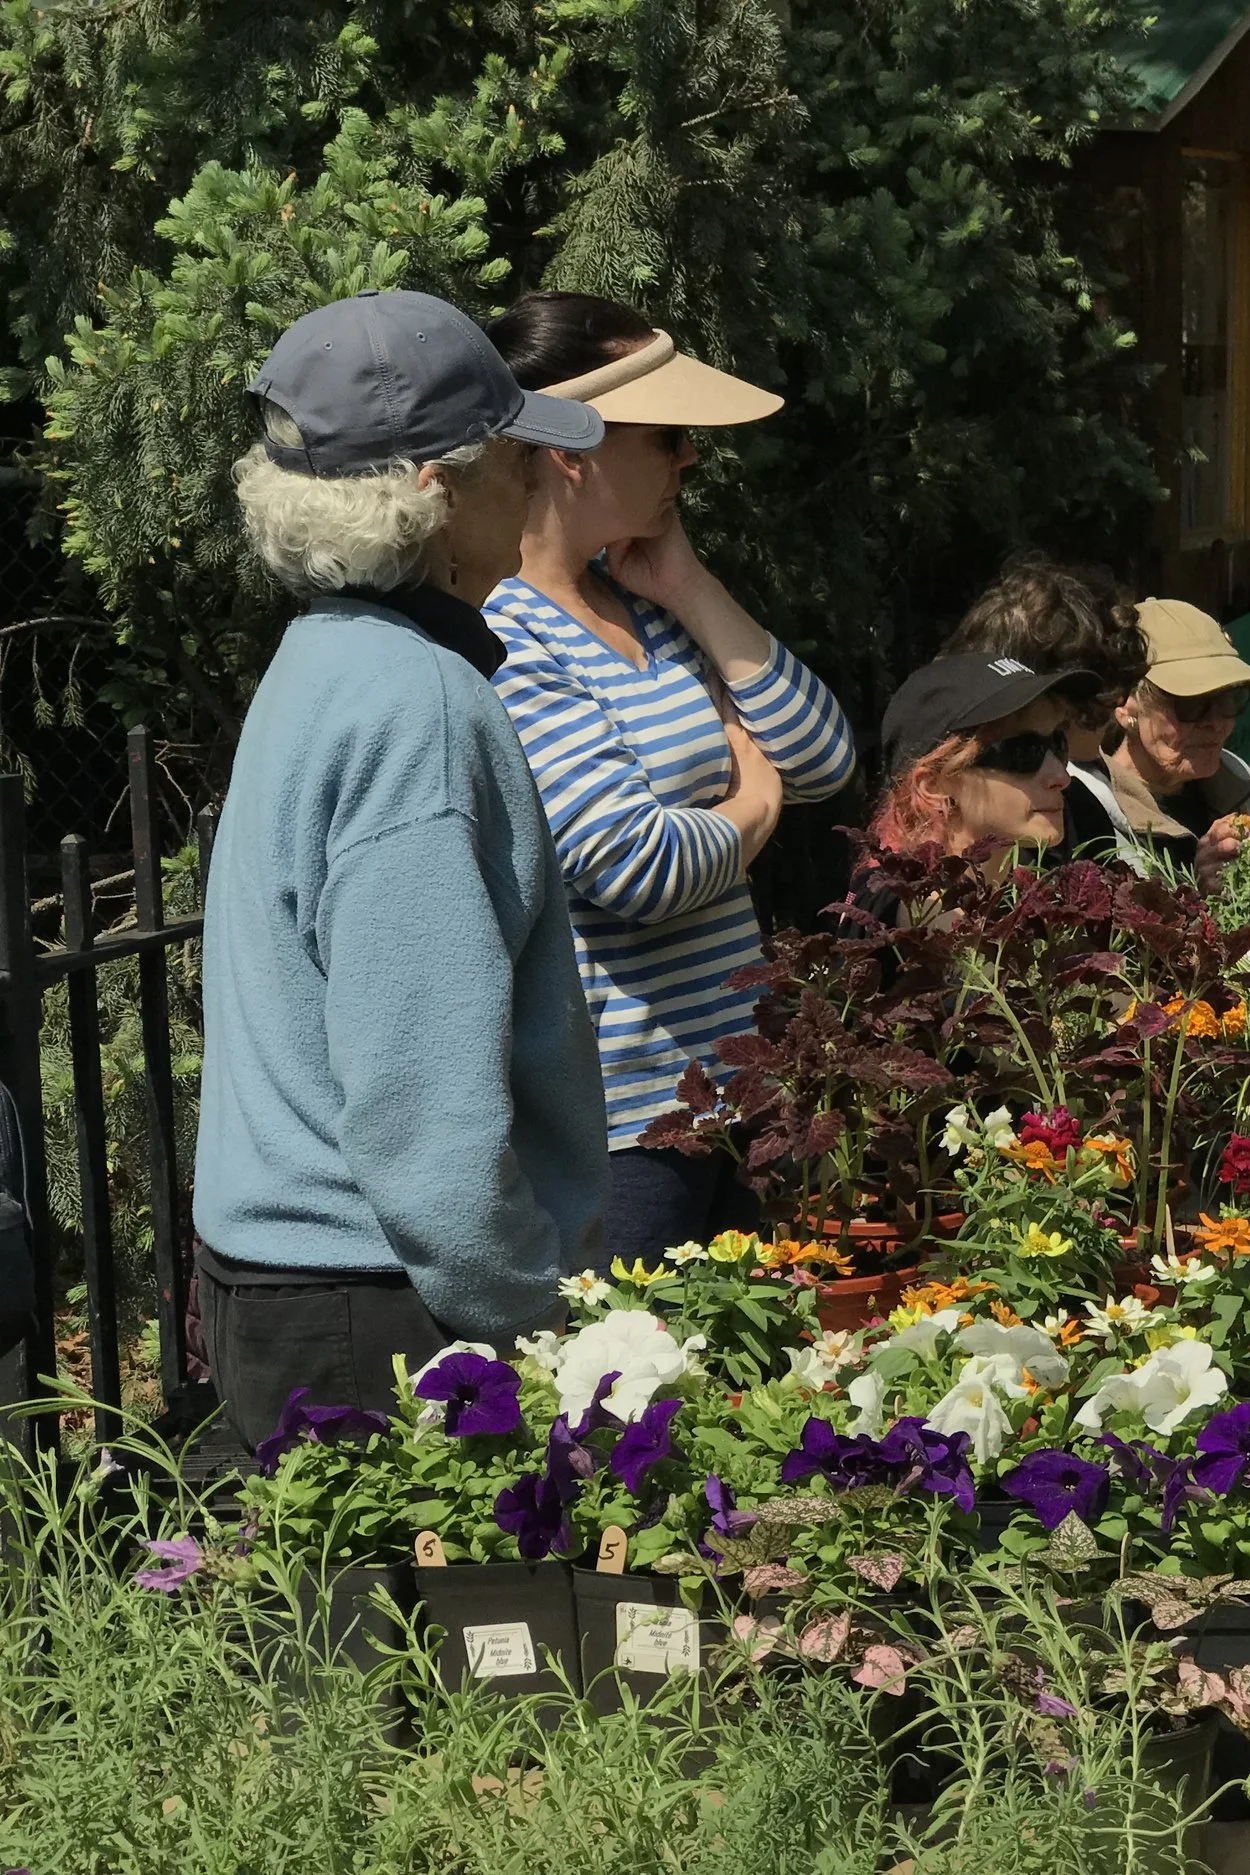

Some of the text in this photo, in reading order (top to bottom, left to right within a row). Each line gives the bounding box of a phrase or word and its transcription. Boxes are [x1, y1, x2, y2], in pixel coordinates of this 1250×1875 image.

[598, 1541, 620, 1560] 5
[648, 1629, 673, 1640] Midnite
[487, 1635, 510, 1645] Petunia
[653, 1638, 668, 1647] blue
[489, 1647, 512, 1657] Midnite
[495, 1657, 510, 1666] blue
